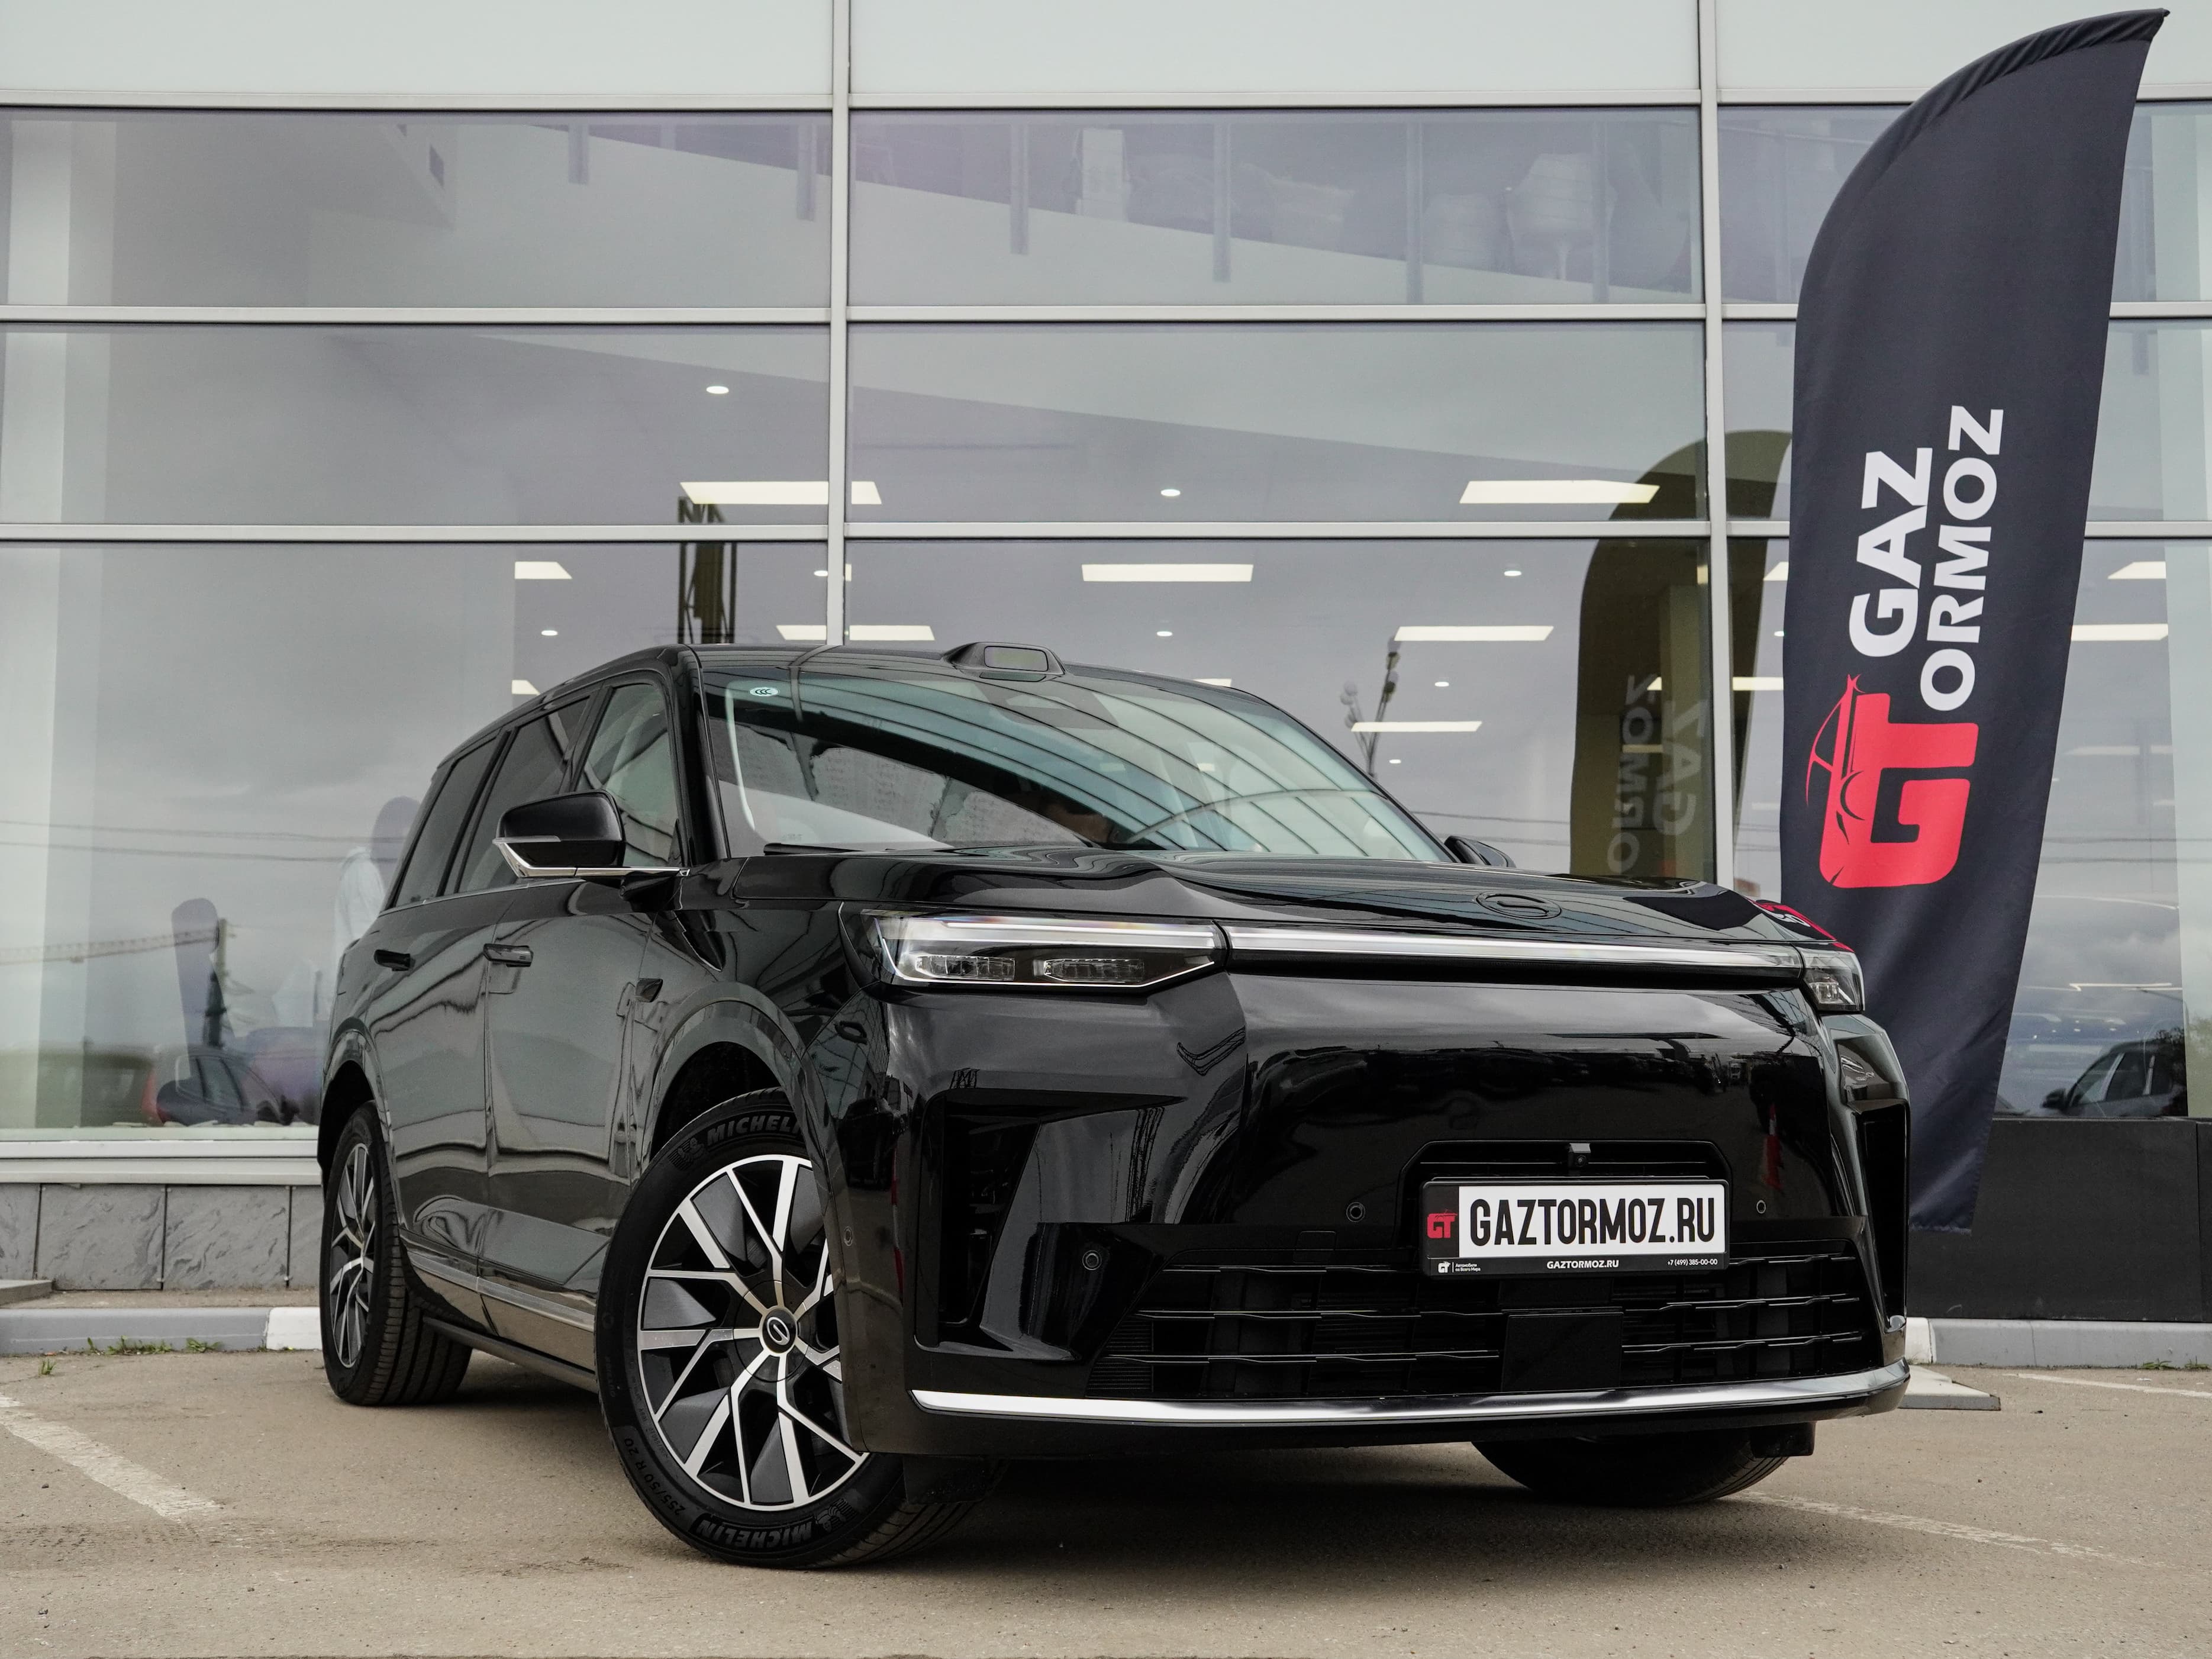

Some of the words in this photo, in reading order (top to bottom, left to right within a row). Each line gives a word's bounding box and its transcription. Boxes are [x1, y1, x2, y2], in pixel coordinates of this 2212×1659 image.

[1849, 447, 1933, 657] GAZ
[1920, 405, 2004, 711] ORMOZ
[1427, 1213, 1457, 1238] GT
[1469, 1197, 1715, 1246] GAZTORMOZ.RU
[1546, 1260, 1619, 1269] GAZTORMOZ.RU
[624, 1438, 640, 1455] 20
[635, 1460, 647, 1471] R
[644, 1474, 686, 1516] 255/50
[695, 1520, 812, 1548] MICHELIN
